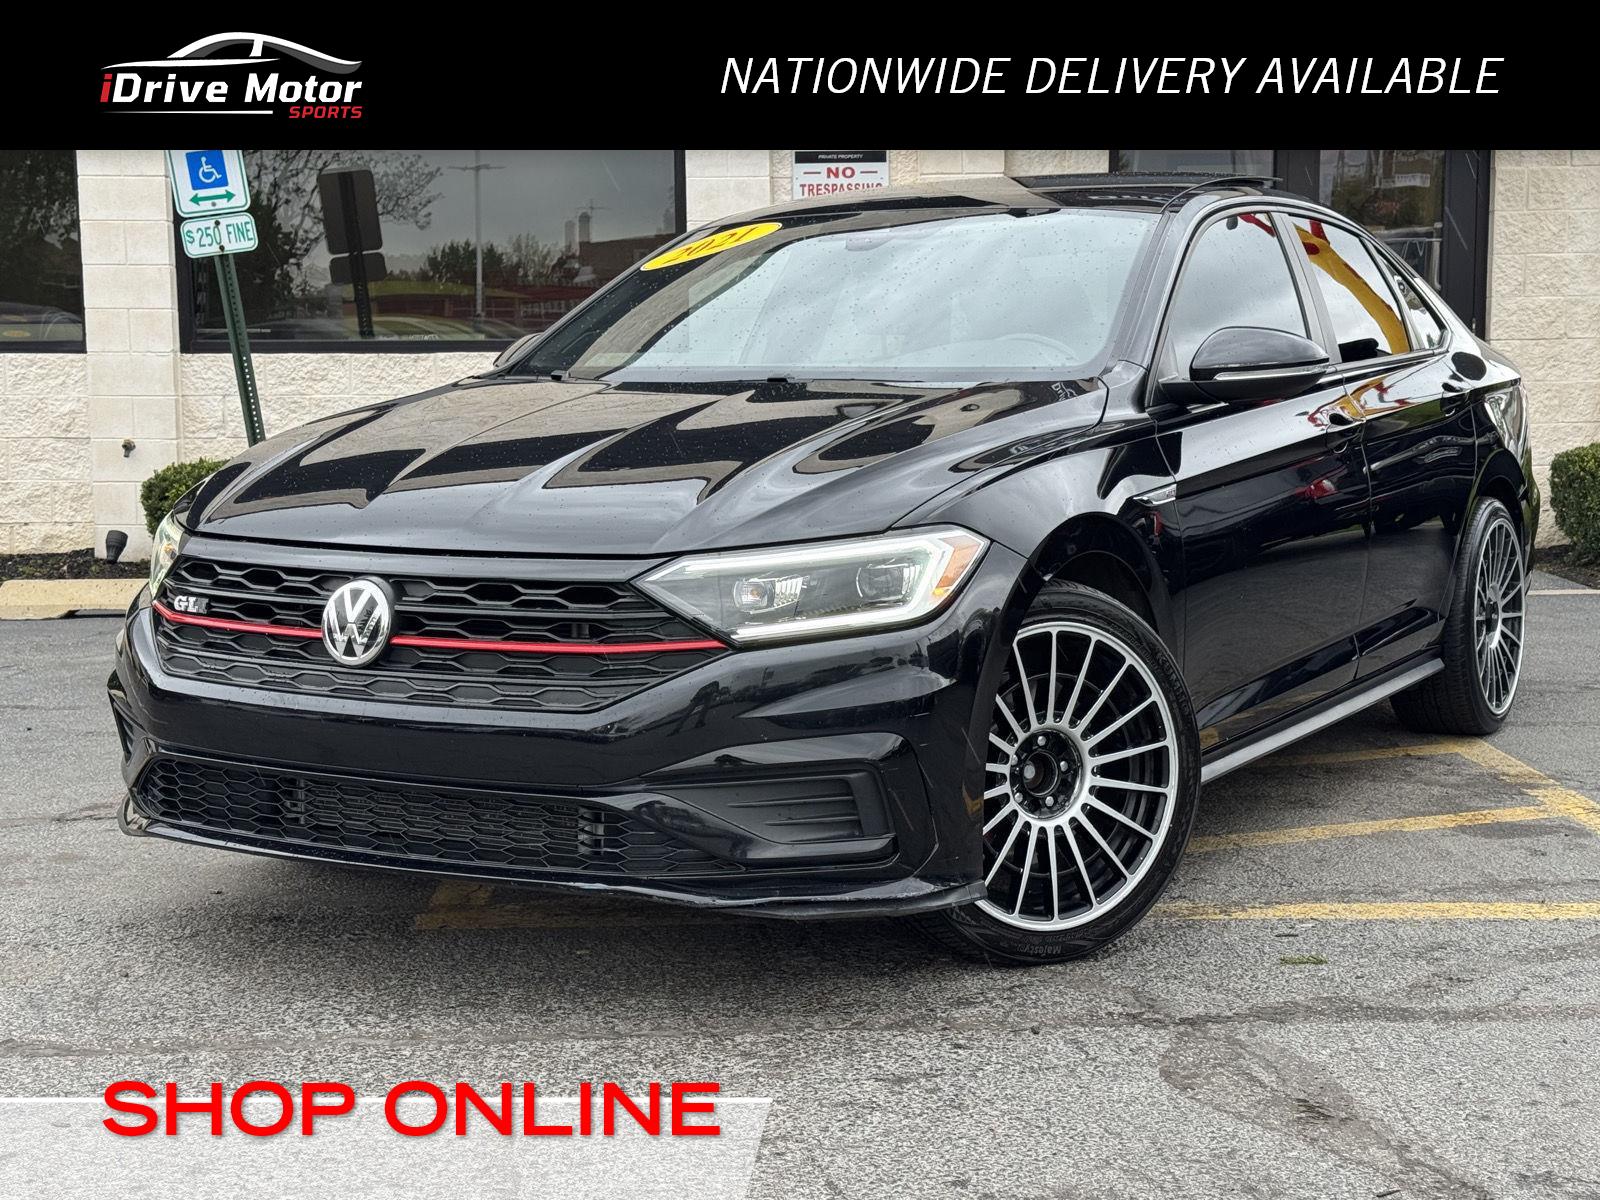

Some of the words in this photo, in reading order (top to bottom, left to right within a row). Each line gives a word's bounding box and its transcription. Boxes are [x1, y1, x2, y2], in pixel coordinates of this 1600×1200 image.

[826, 166, 856, 179] NO
[225, 221, 254, 245] FINE
[173, 594, 210, 615] GLI
